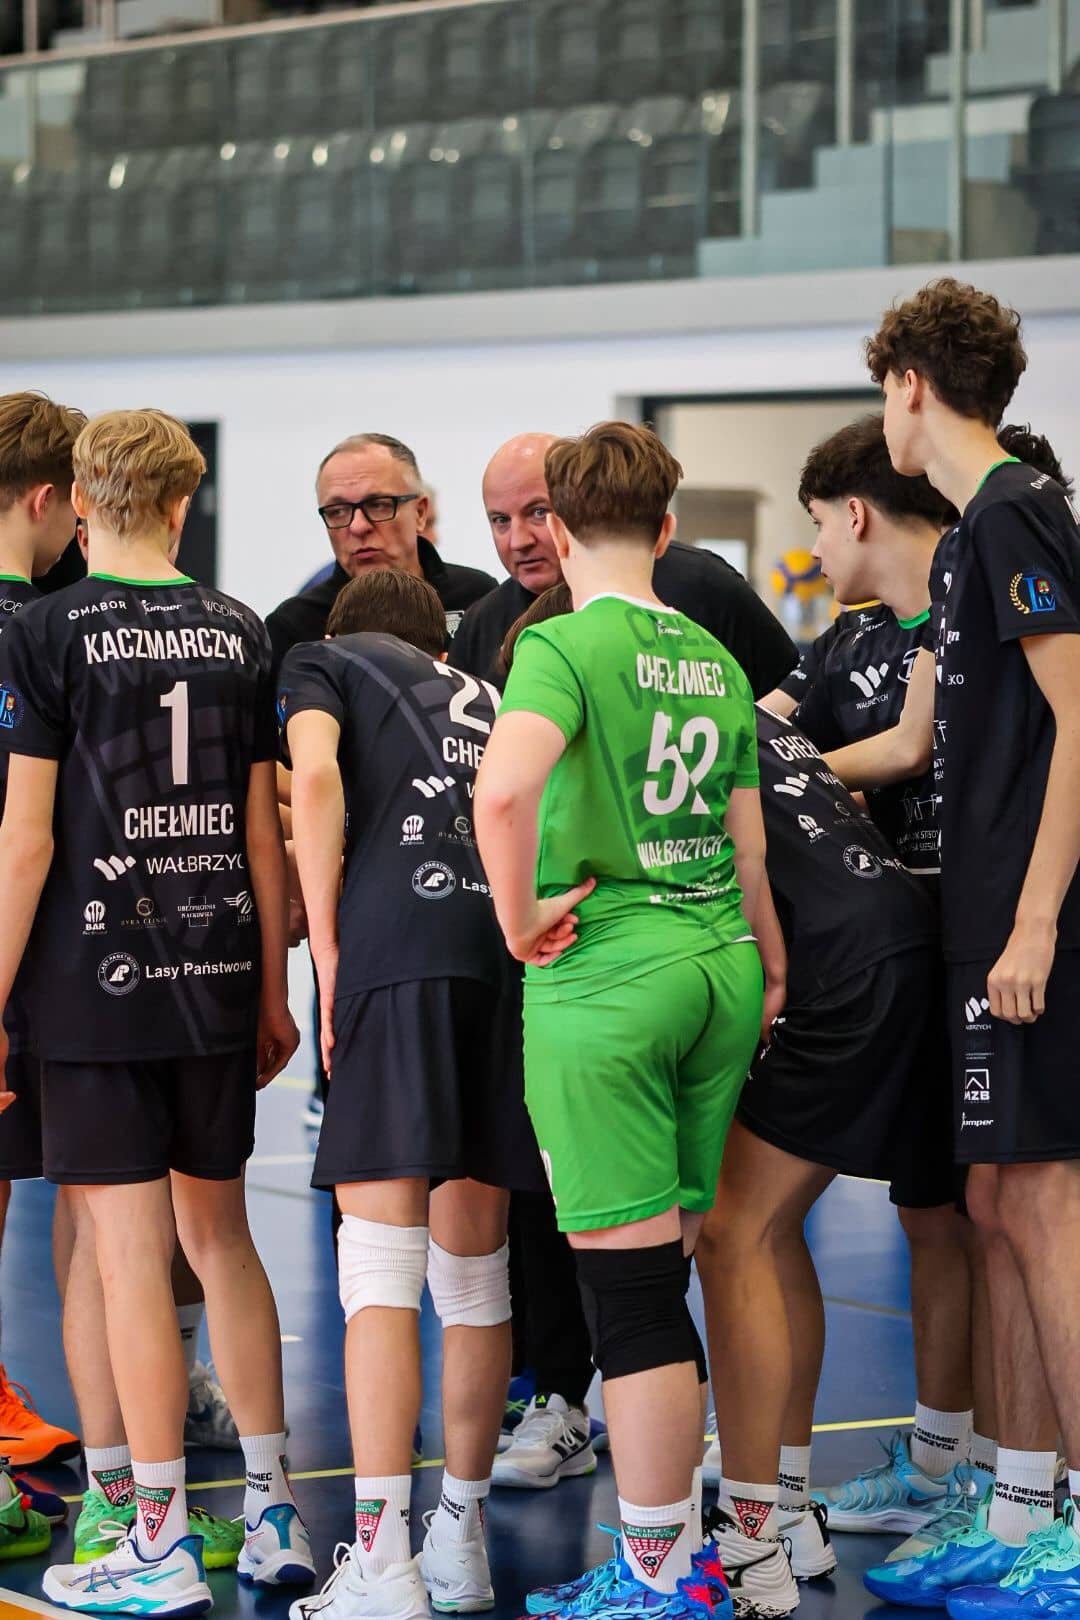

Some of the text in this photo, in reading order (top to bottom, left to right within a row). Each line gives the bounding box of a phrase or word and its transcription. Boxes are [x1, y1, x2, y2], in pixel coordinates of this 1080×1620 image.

[636, 653, 726, 697] CHEŁMIEC
[160, 681, 189, 785] 1
[124, 804, 235, 840] CHEŁMIEC
[637, 832, 726, 869] WAŁBRZYCH
[86, 922, 105, 931] BAR
[146, 960, 253, 980] Lasy Państwowe
[995, 1489, 1053, 1509] WAŁBRZYCH
